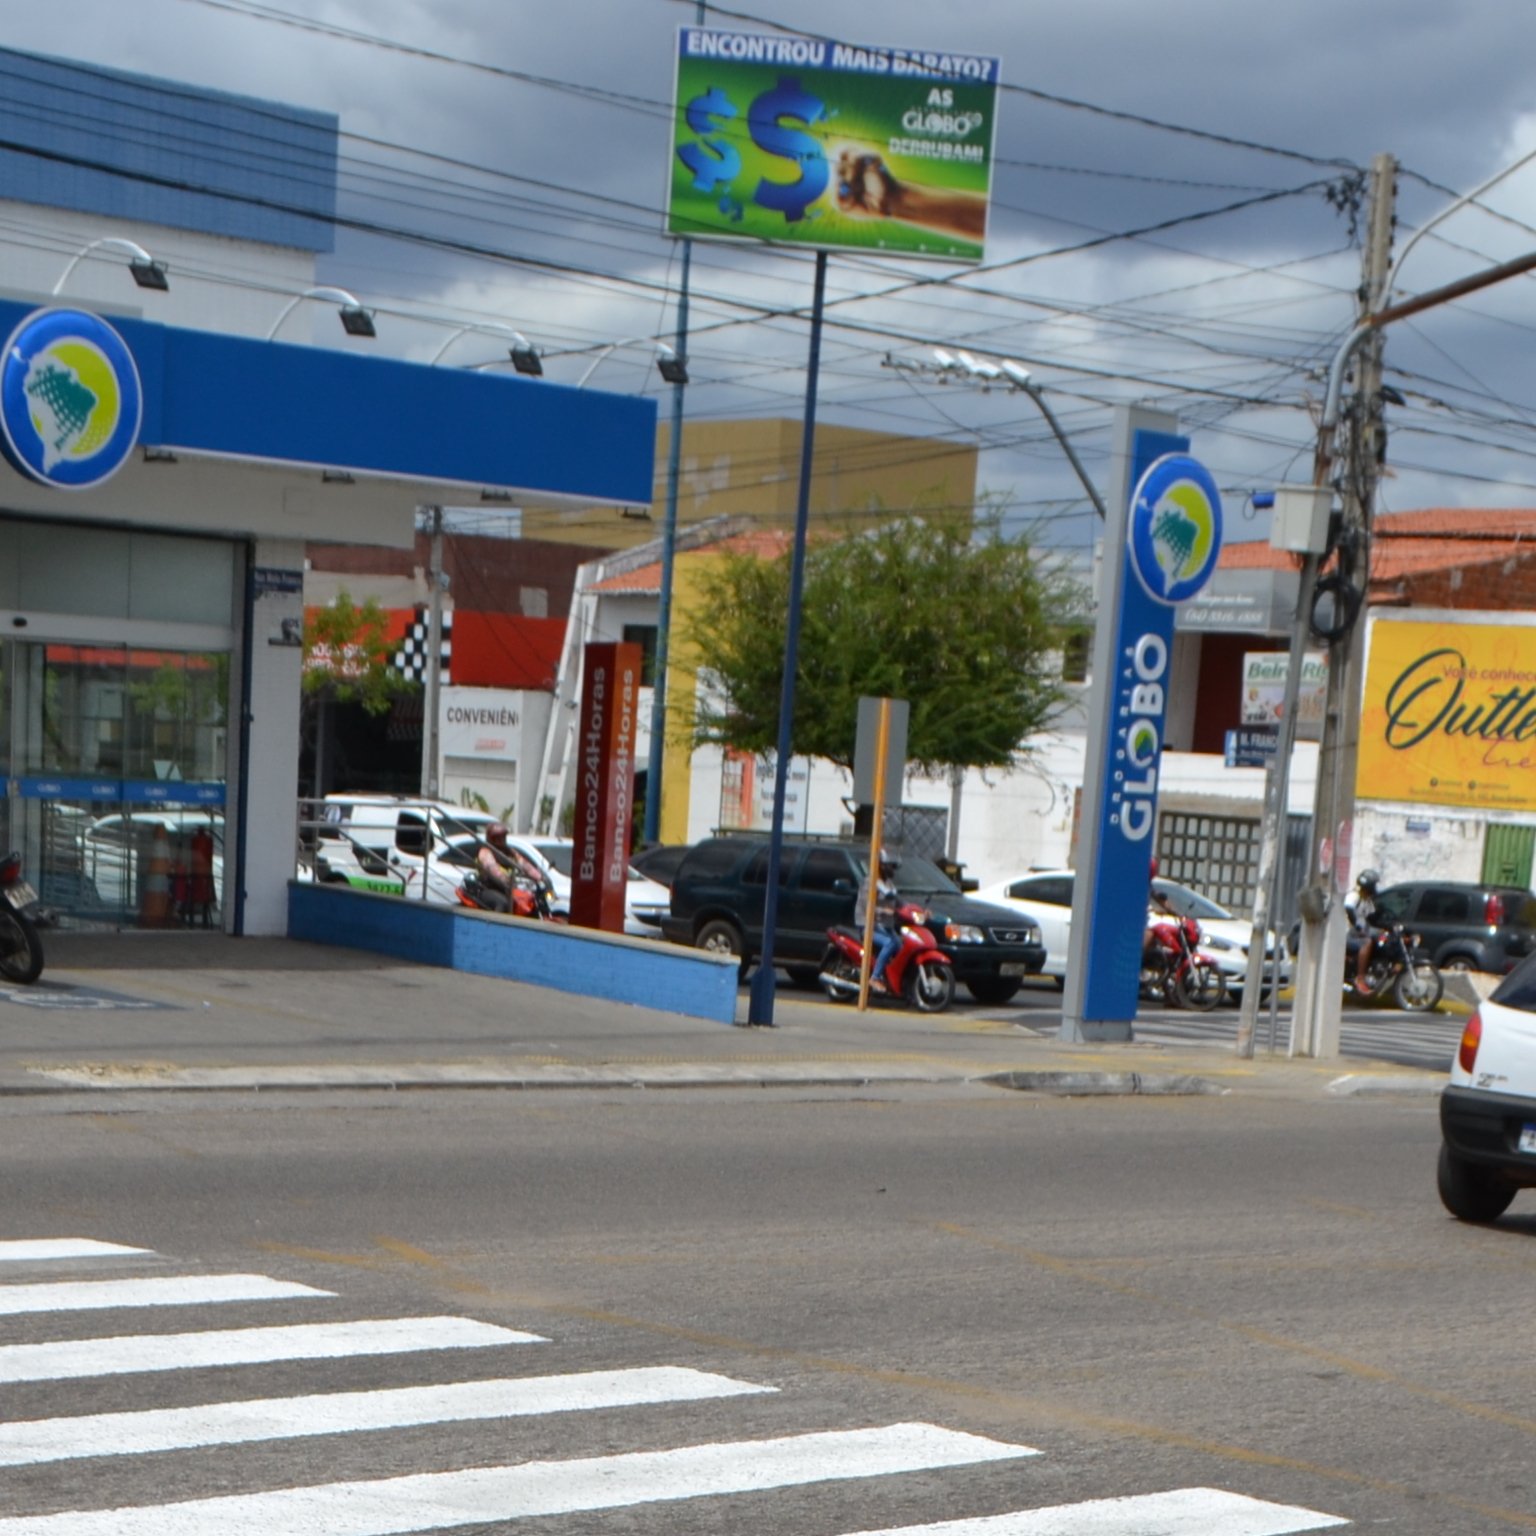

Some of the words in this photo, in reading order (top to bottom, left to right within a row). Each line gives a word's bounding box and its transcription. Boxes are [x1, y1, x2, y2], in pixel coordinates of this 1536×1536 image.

[688, 31, 825, 64] ENCONTROU
[833, 43, 889, 70] MAIS
[892, 51, 992, 82] BARATO?
[927, 87, 954, 107] AS
[902, 110, 971, 135] GLOBO
[889, 138, 984, 162] DERRUBAM!
[1248, 662, 1289, 680] Beir
[1444, 664, 1478, 681] Você
[1109, 646, 1136, 825] DROGARIAS
[1120, 633, 1168, 842] GLOBO
[580, 667, 607, 882] Banco24Horas
[610, 669, 634, 883] Banco24Horas
